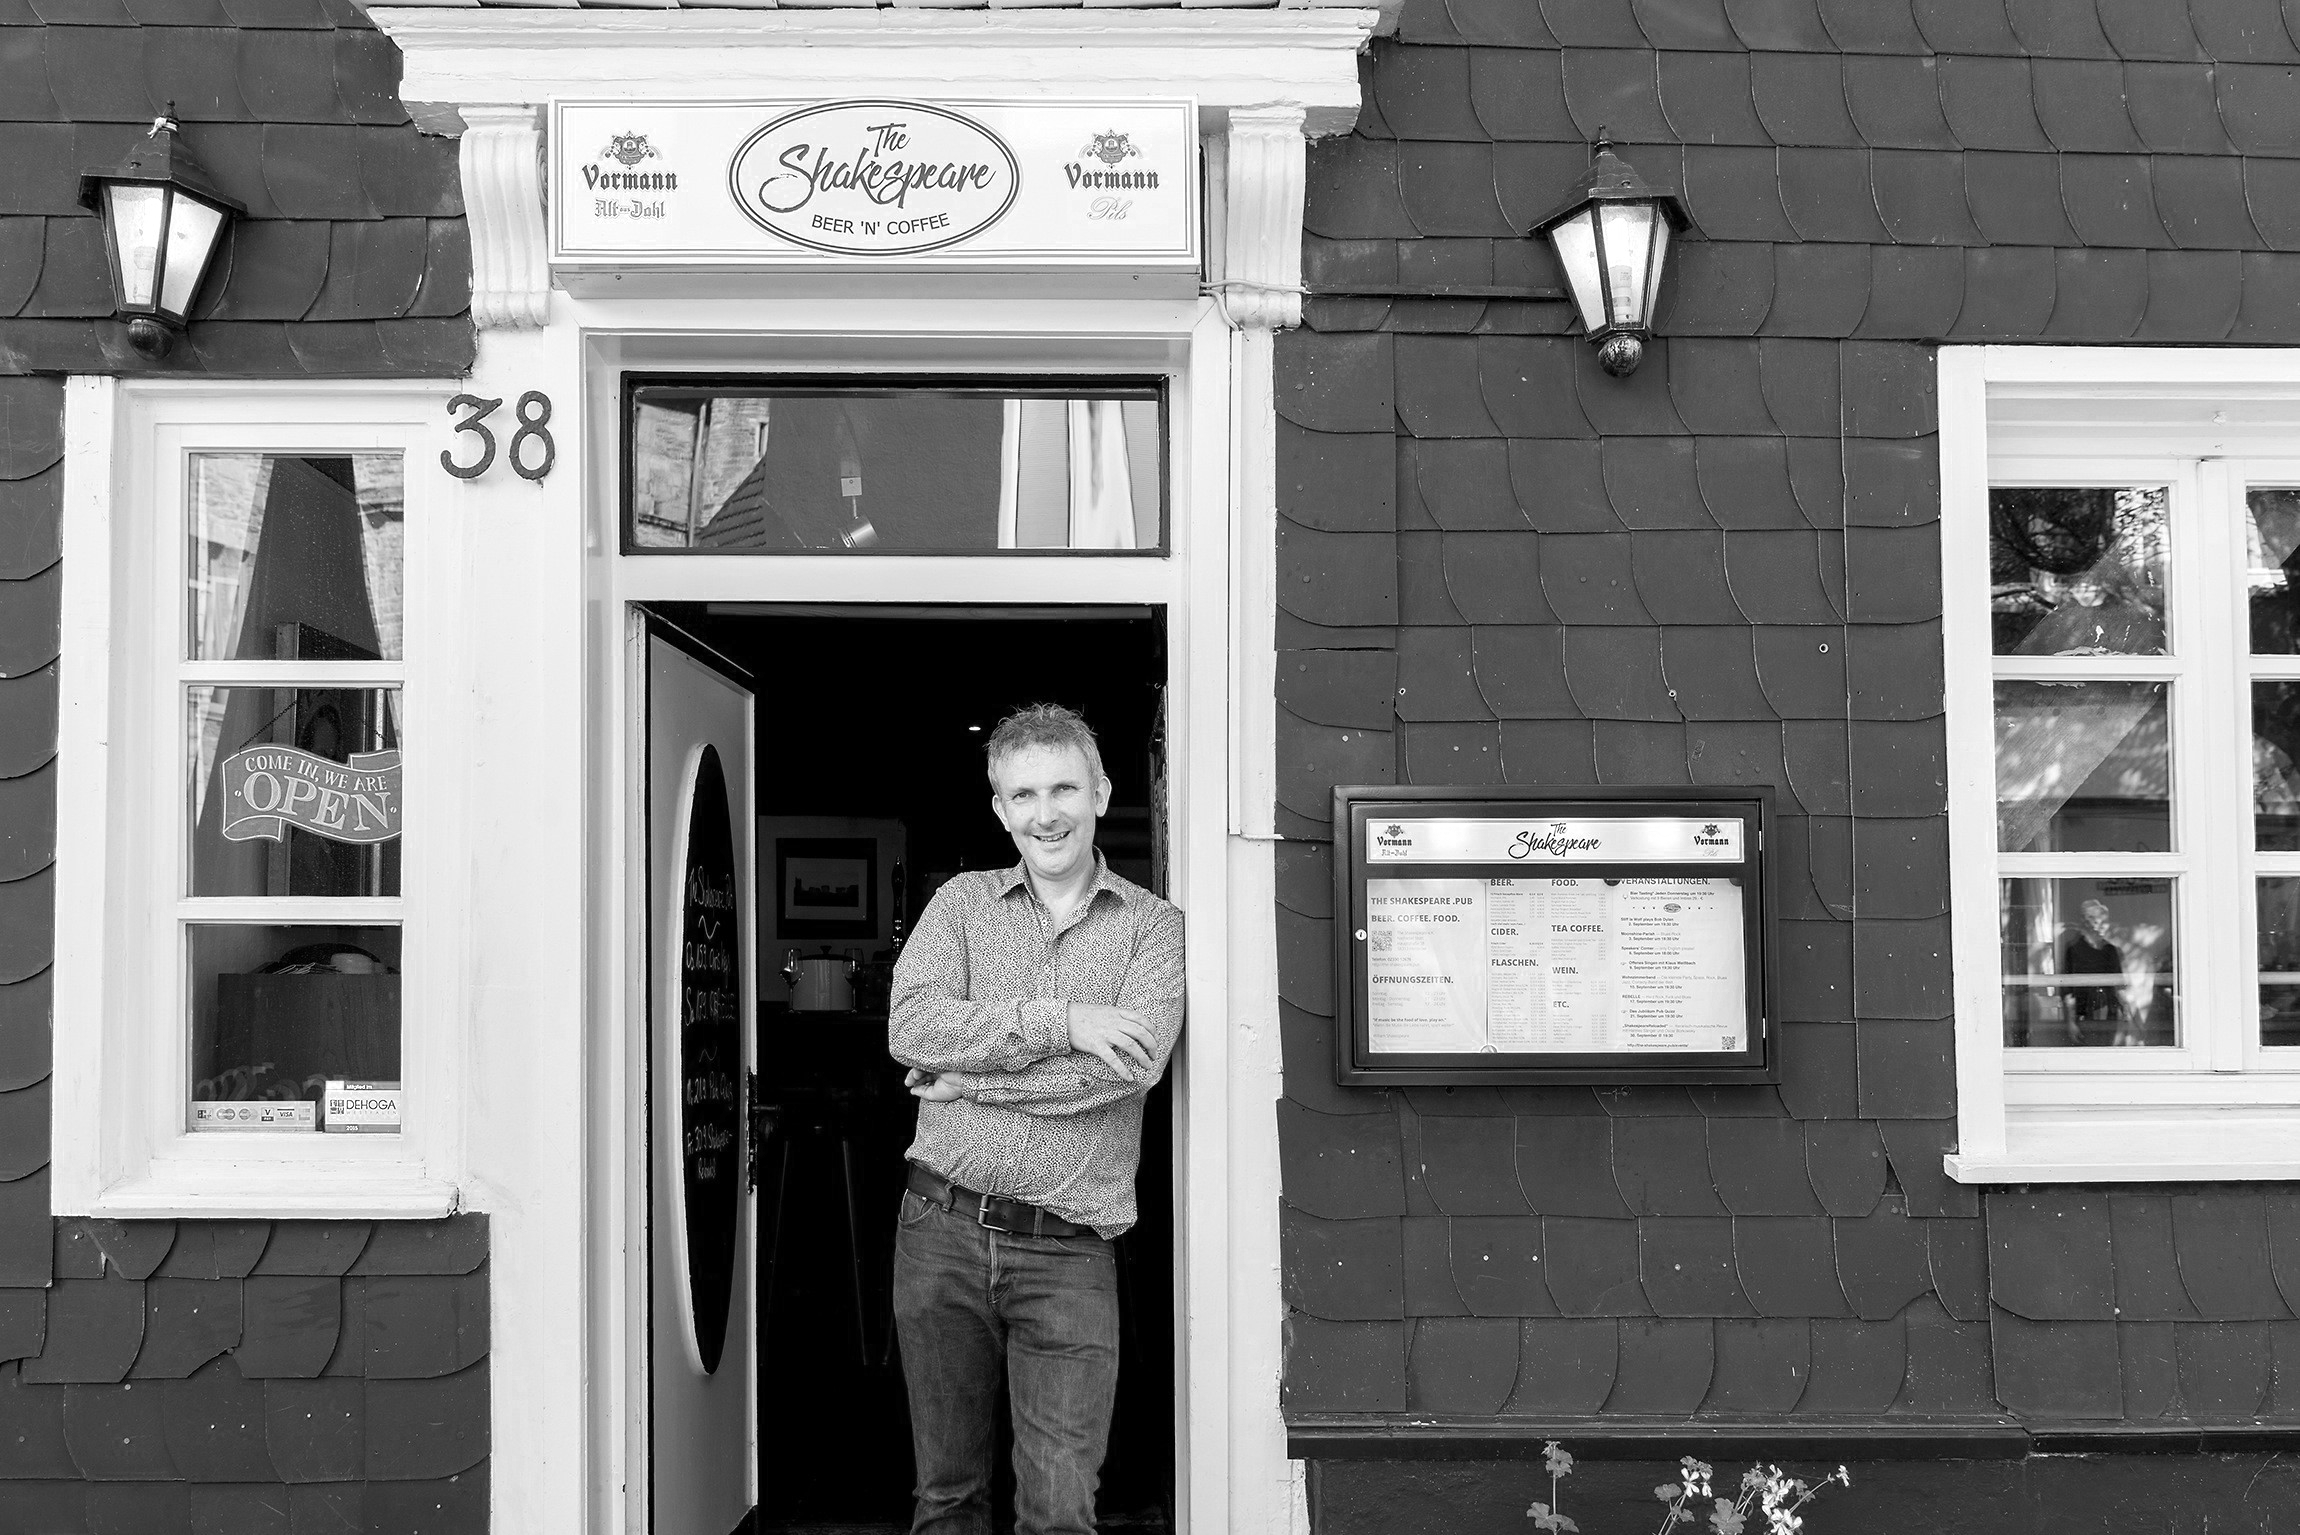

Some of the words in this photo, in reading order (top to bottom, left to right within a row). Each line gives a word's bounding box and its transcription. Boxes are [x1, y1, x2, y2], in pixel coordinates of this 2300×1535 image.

[866, 123, 910, 156] The
[582, 164, 678, 190] Vormann
[759, 143, 996, 214] Shakespeare
[1064, 162, 1160, 190] Vormann
[1087, 196, 1132, 220] Pils
[812, 214, 855, 235] BEER
[860, 220, 881, 236] 'N'
[886, 213, 951, 236] COFFEE
[440, 391, 556, 481] 38
[244, 755, 293, 772] COME
[297, 759, 319, 783] IN,
[324, 769, 349, 788] WE
[353, 775, 388, 792] ARE
[243, 772, 392, 831] OPEN
[1377, 836, 1412, 846] Vormann
[1550, 822, 1568, 836] The
[1694, 836, 1729, 846] Vormann
[1508, 830, 1602, 859] Shakespeare
[1372, 975, 1454, 984] ÖFFNUNGSZEITEN.
[346, 1100, 396, 1110] DEHOGA
